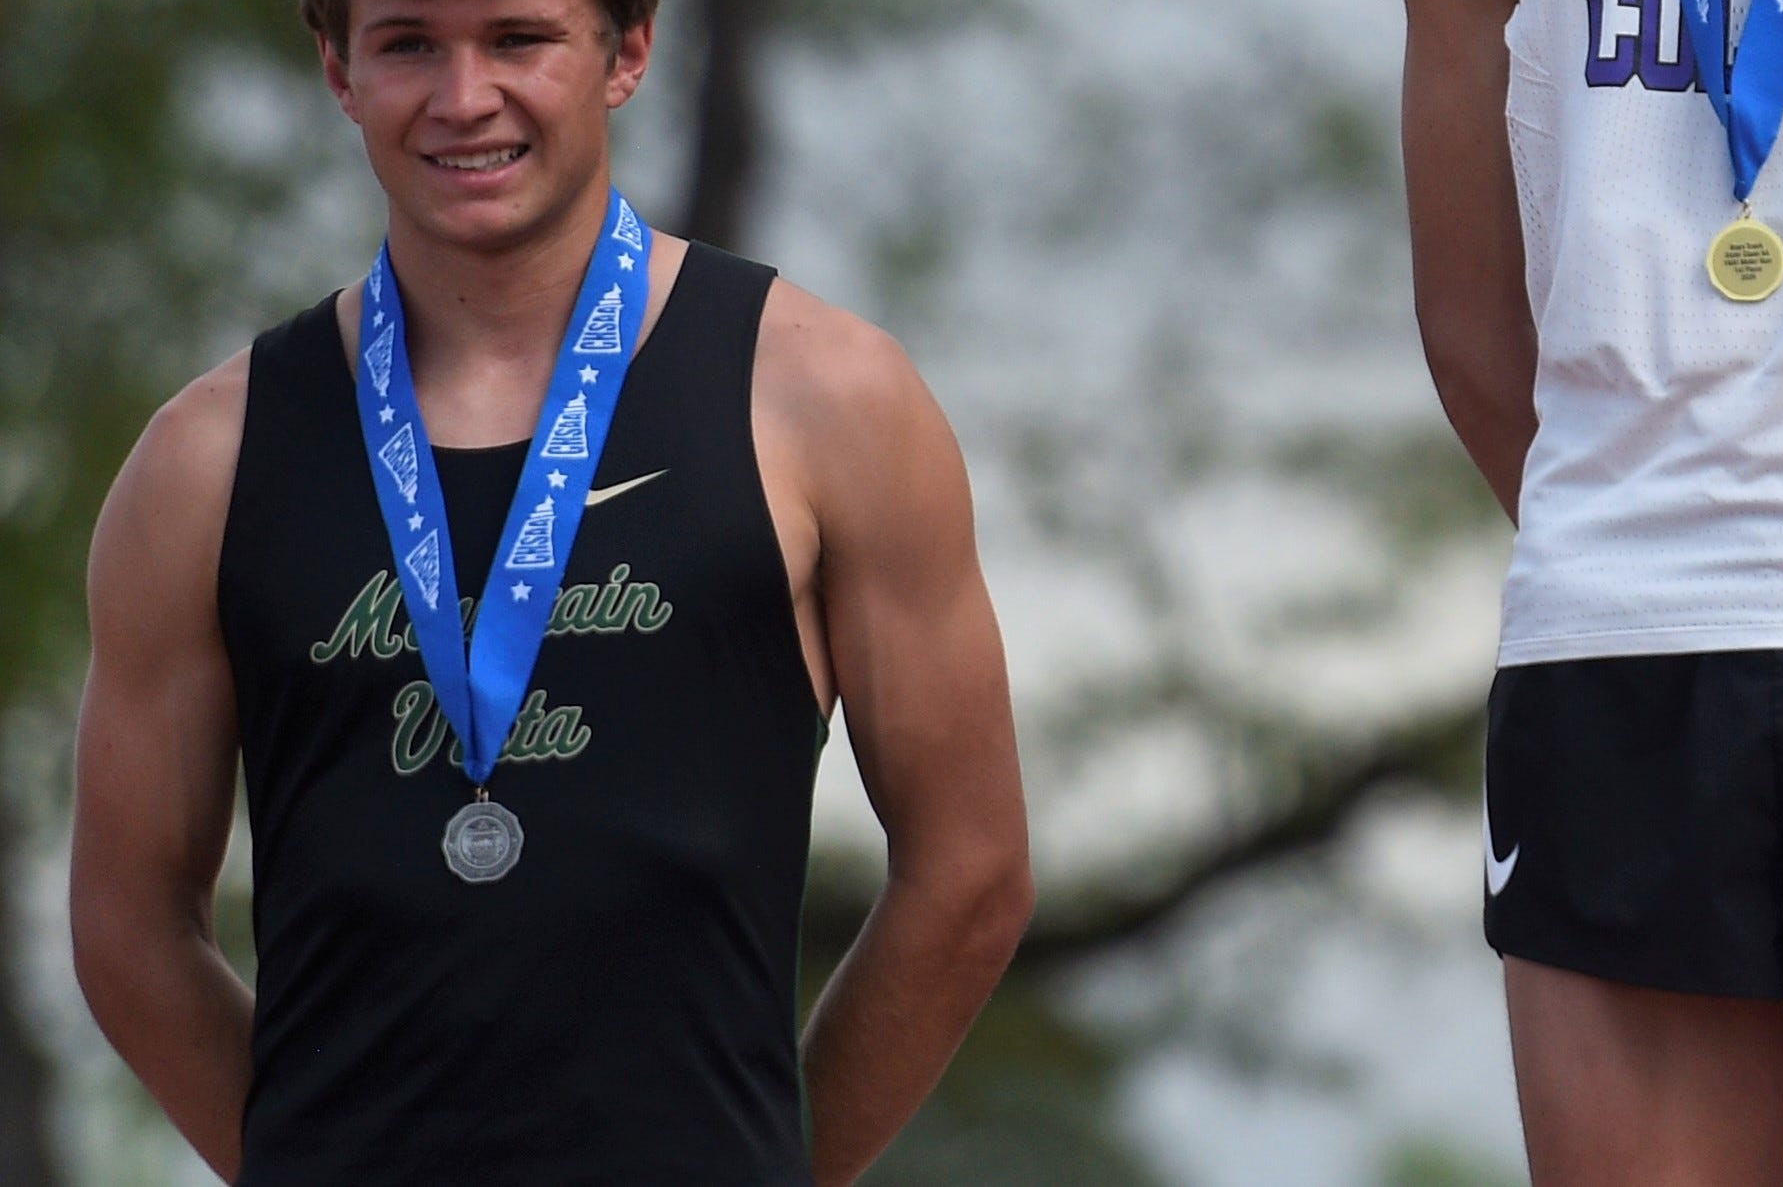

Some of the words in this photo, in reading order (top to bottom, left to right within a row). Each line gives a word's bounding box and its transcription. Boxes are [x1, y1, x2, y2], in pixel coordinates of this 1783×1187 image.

[579, 305, 619, 351] CHSAA
[546, 413, 585, 455] CHSAA
[511, 517, 551, 565] CHSAA
[311, 564, 673, 663] Main
[392, 680, 592, 774] Vta
